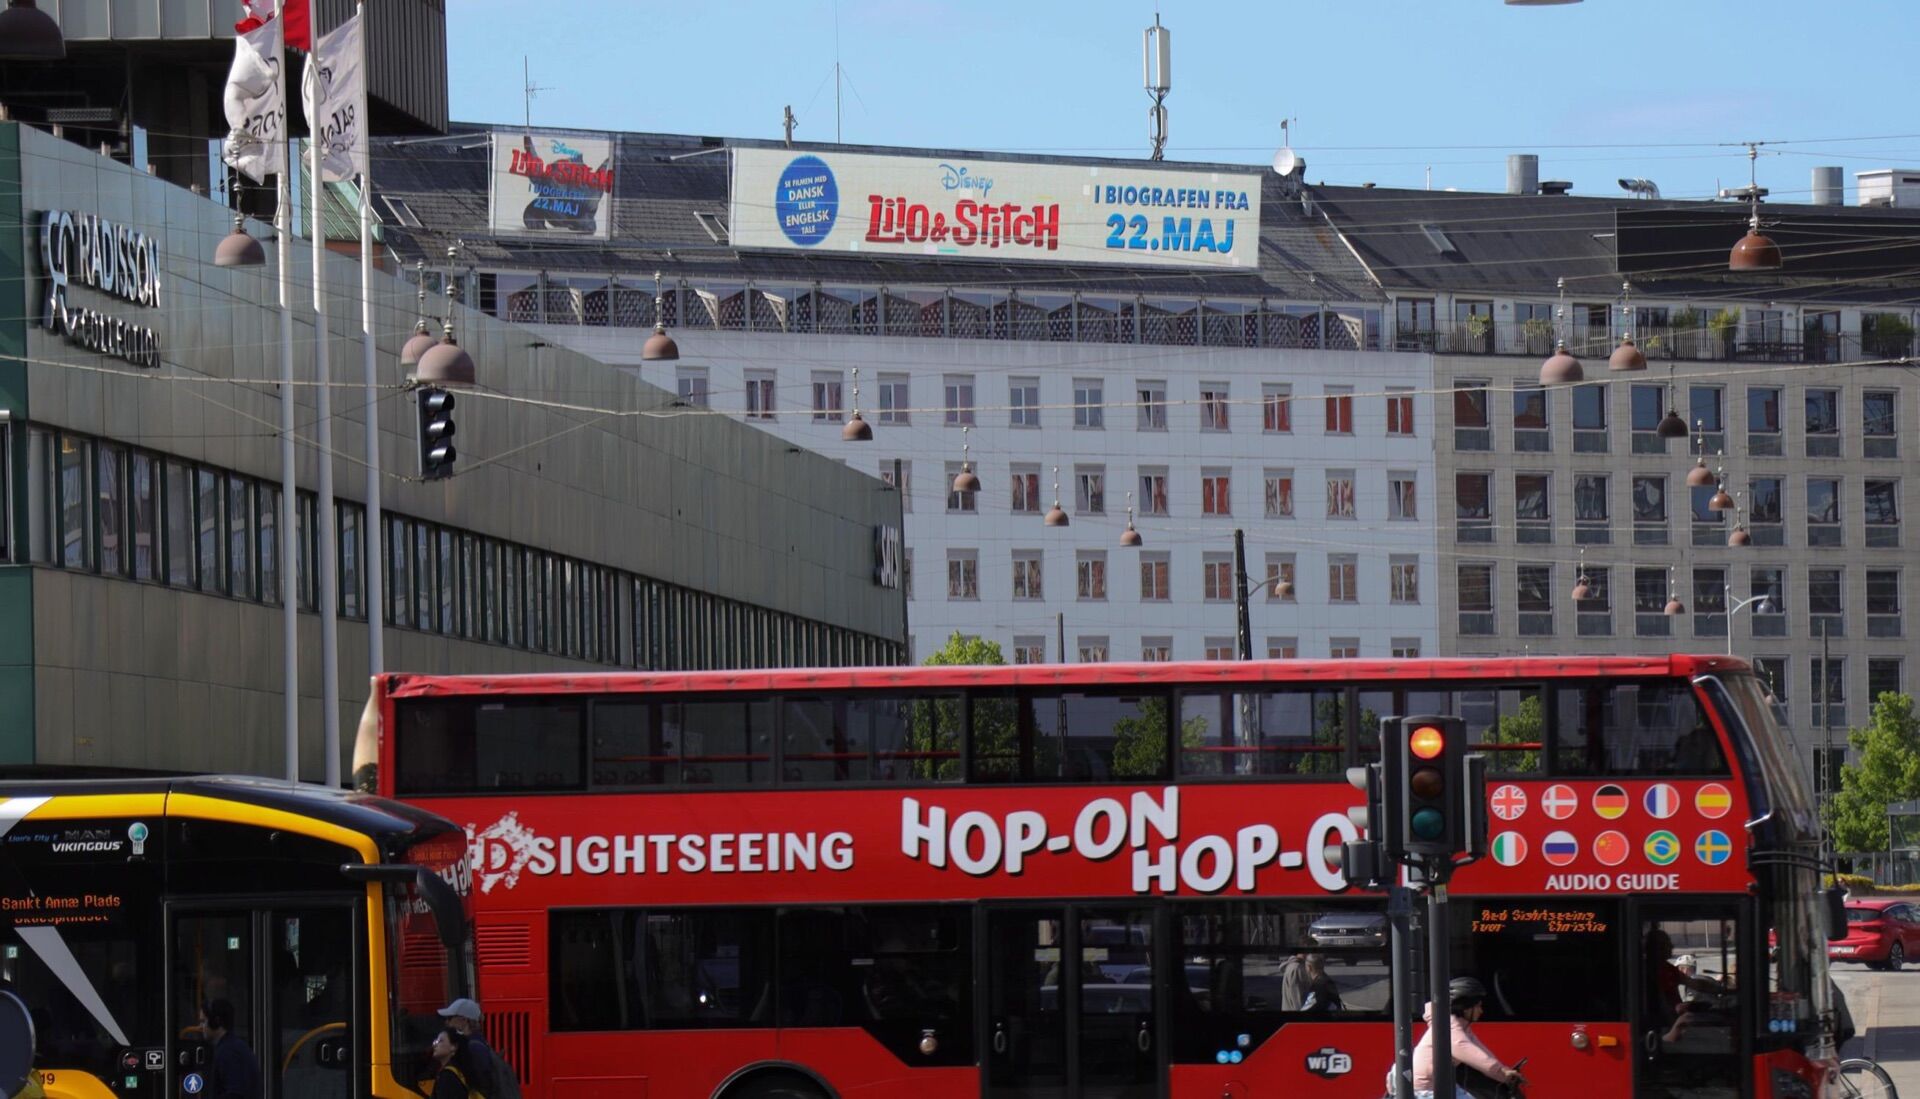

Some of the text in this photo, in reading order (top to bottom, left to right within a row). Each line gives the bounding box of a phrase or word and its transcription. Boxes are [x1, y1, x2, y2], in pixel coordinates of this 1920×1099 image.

[784, 175, 827, 188] SE FILMEN MED
[789, 185, 824, 201] DANSK
[1094, 184, 1250, 211] I BIOGRAFEN FRA
[533, 198, 579, 216] 22.MAJ
[798, 201, 816, 210] ELLER
[786, 209, 829, 227] ENGELSK
[801, 225, 816, 235] TALE
[1106, 213, 1235, 254] 22.MAJ
[77, 210, 160, 308] RADISSON
[79, 307, 161, 368] COLLECTION
[64, 829, 111, 840] MAN
[901, 786, 1179, 876] HOP-ON
[52, 840, 122, 853] VIKINGBUS
[528, 831, 854, 876] SIGHTSEEING
[1132, 812, 1420, 893] HOP-O
[1545, 873, 1680, 890] AUDIO GUIDE
[1, 896, 41, 910] Sankt
[84, 894, 121, 908] Plads
